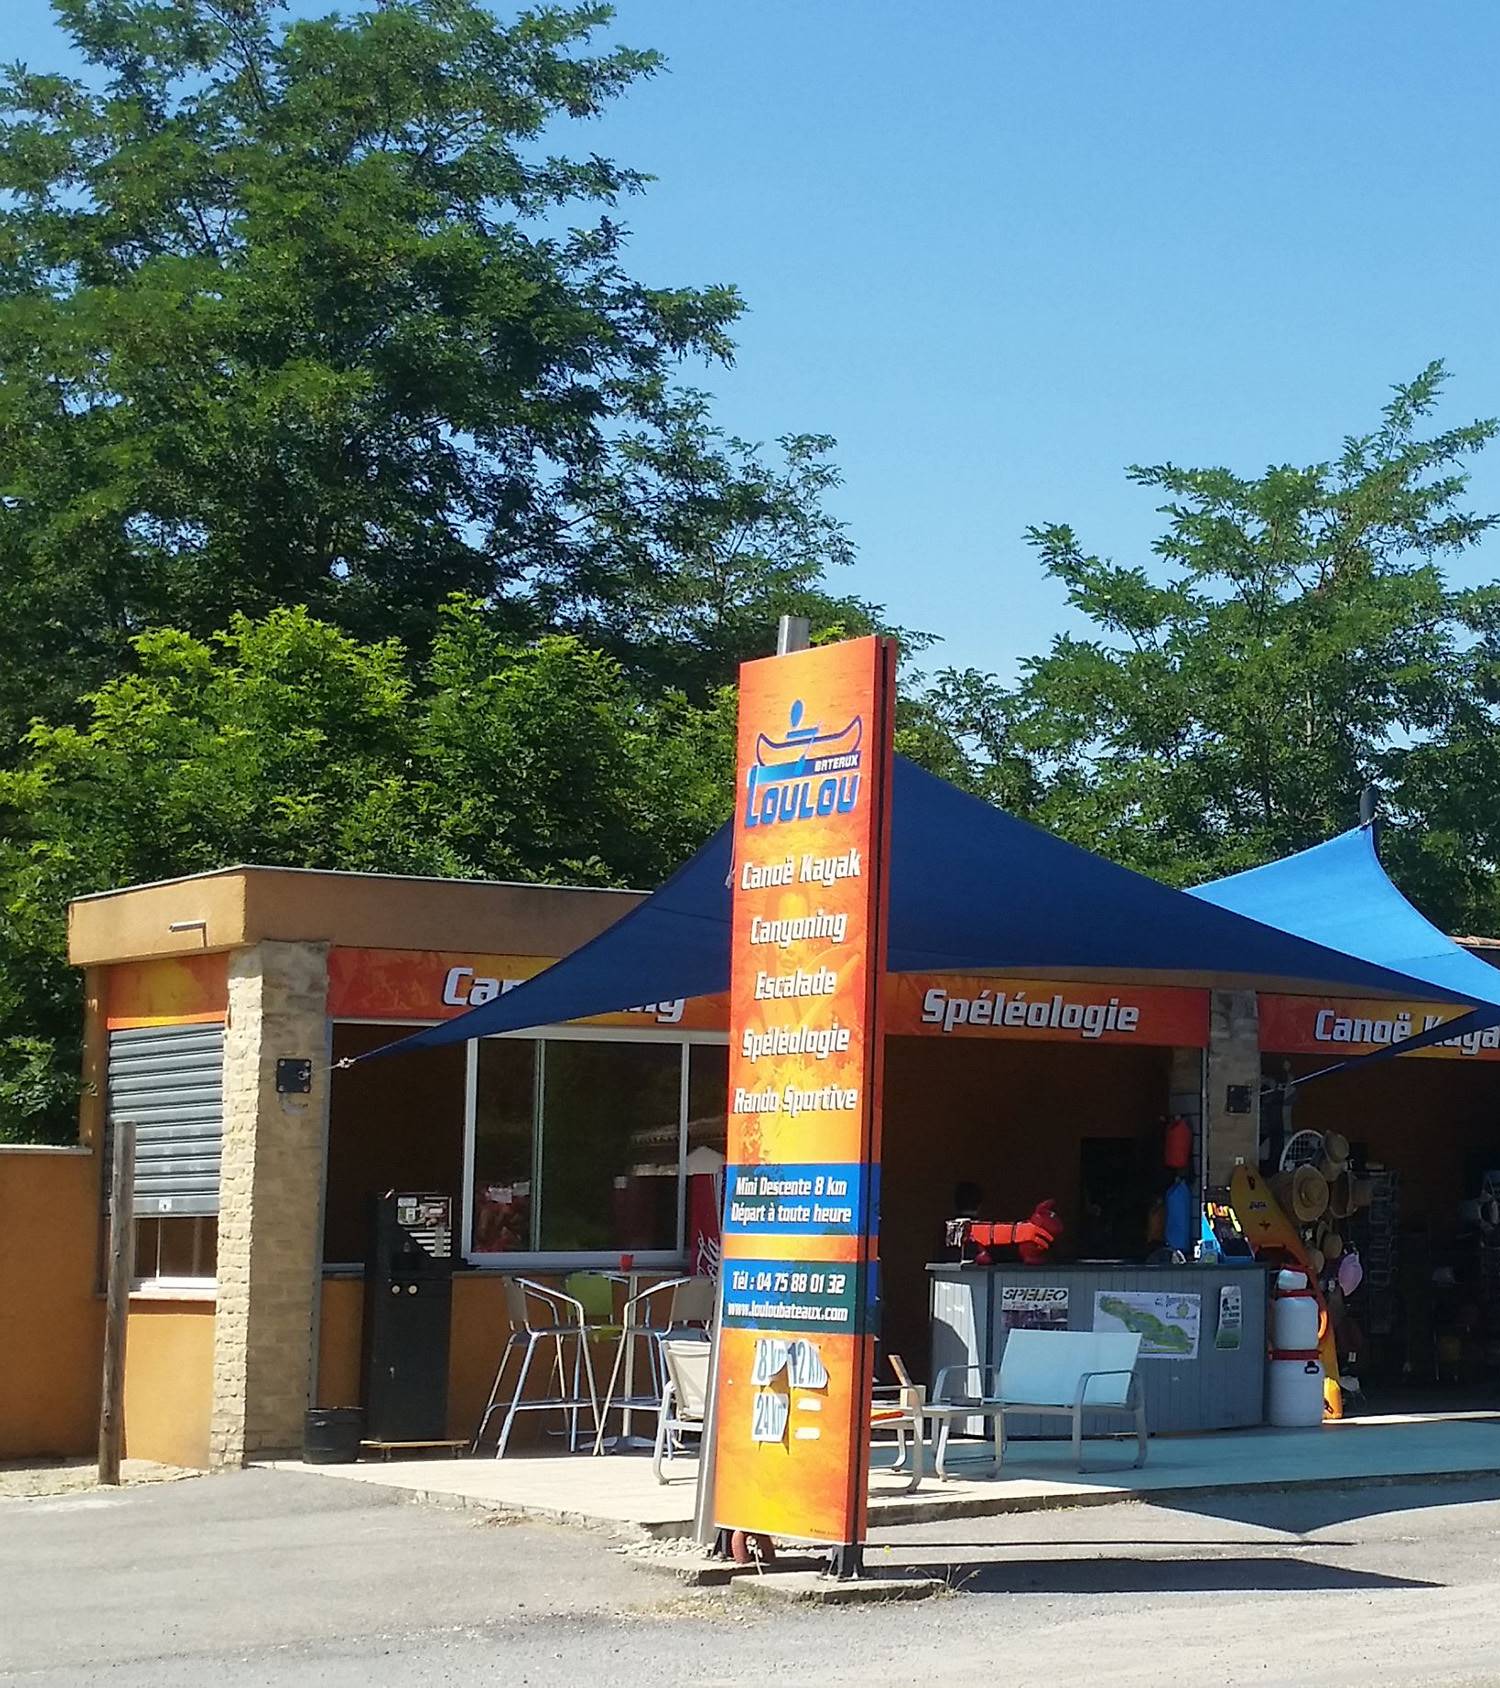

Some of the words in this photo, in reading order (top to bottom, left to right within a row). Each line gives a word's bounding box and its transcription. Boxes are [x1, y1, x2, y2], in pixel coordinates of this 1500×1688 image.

[745, 768, 861, 828] LOULOU
[799, 848, 861, 887] Kayak
[750, 909, 847, 948] Canyoning
[754, 966, 837, 1000] Escalade
[922, 988, 1139, 1038] Spéléologie
[1314, 1009, 1412, 1044] Canoë
[741, 1022, 850, 1063] Spéléologie
[733, 1084, 778, 1114] Rando
[782, 1083, 857, 1117] Sportive
[735, 1177, 757, 1196] Mini
[759, 1177, 811, 1196] Descente
[814, 1176, 825, 1196] 8
[826, 1177, 847, 1196] km
[731, 1202, 766, 1226] Départ
[768, 1203, 776, 1222] à
[778, 1204, 810, 1222] toute
[813, 1204, 852, 1223] heure
[732, 1271, 749, 1290] Tél
[756, 1272, 771, 1291] 04
[773, 1273, 788, 1292] 75
[790, 1274, 807, 1292] 88
[810, 1274, 825, 1293] 01
[826, 1275, 846, 1294] 32
[727, 1300, 848, 1322] www.louloubateaux.com
[757, 1339, 767, 1381] 8
[788, 1341, 806, 1385] 12
[754, 1394, 769, 1435] 24
